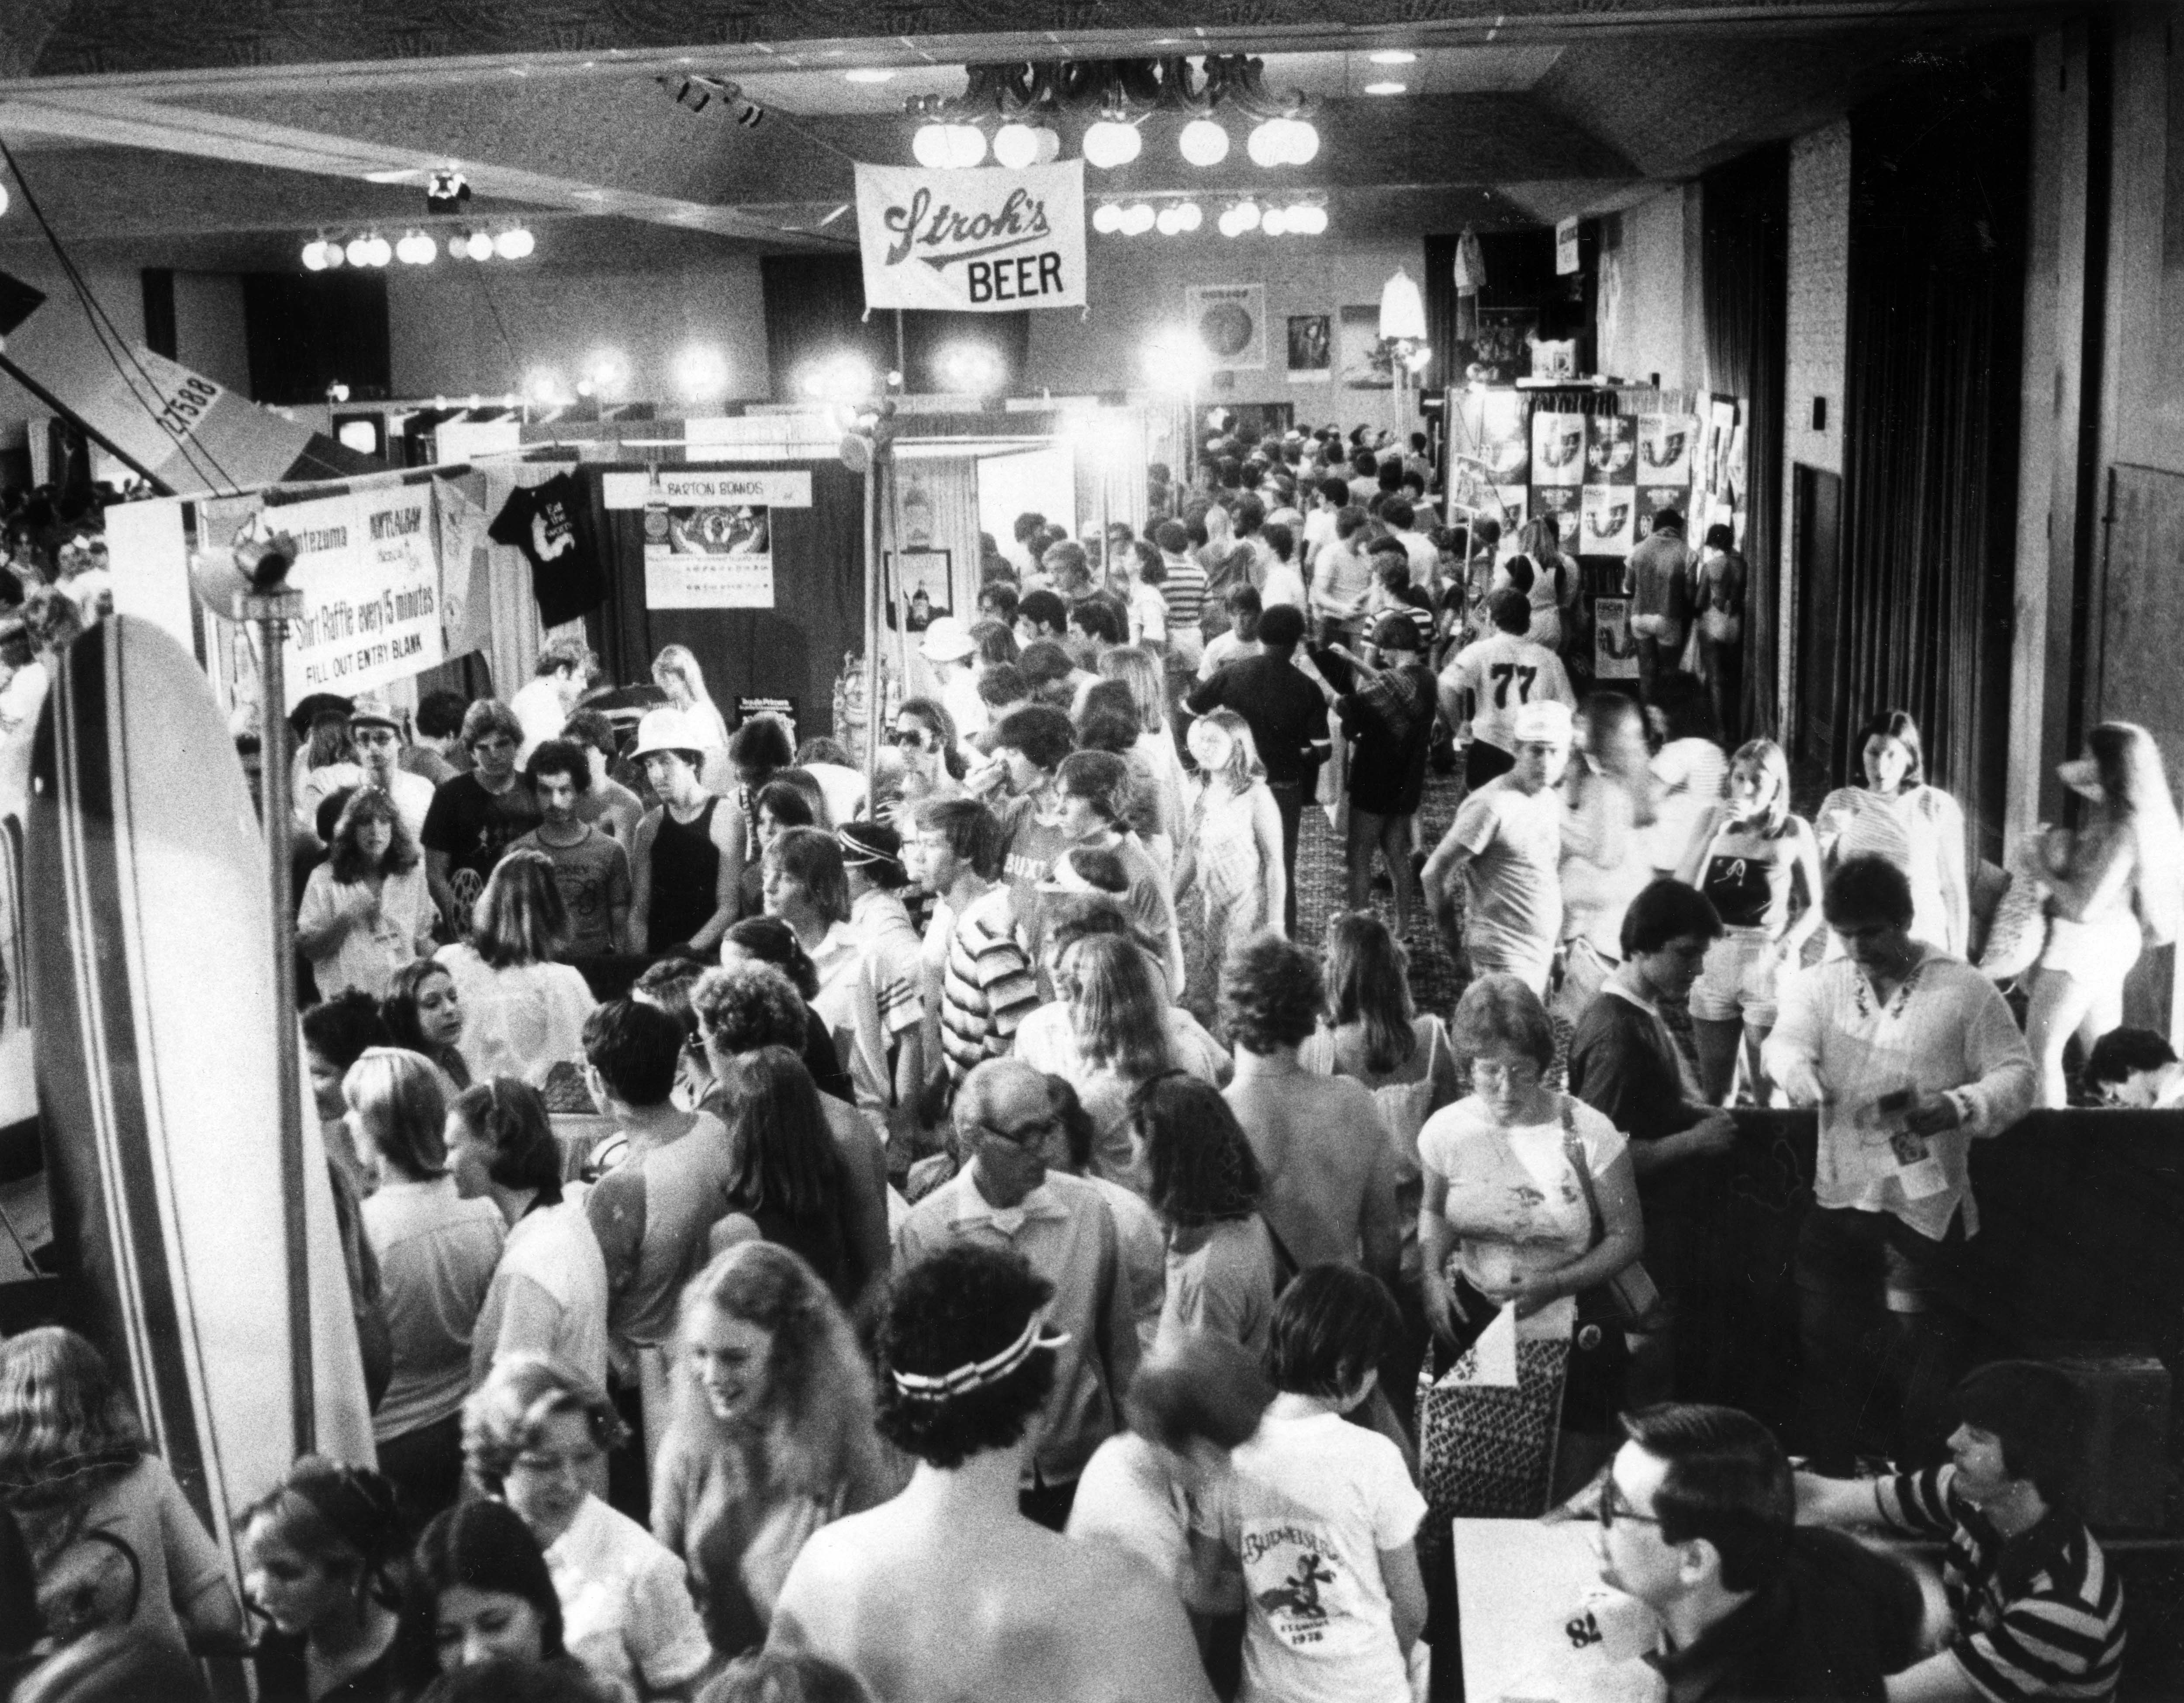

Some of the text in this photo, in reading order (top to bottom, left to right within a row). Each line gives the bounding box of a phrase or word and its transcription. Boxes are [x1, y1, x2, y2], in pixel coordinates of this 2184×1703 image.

[883, 187, 1050, 266] Stroh's
[968, 251, 1064, 303] BEER
[667, 482, 715, 495] BARTON
[321, 600, 353, 642] Raffle
[358, 601, 383, 636] every
[383, 588, 394, 624] 15
[395, 584, 434, 621] minutes
[306, 633, 422, 686] FILL OUT ENTRY BLANK
[1490, 662, 1537, 710] 77
